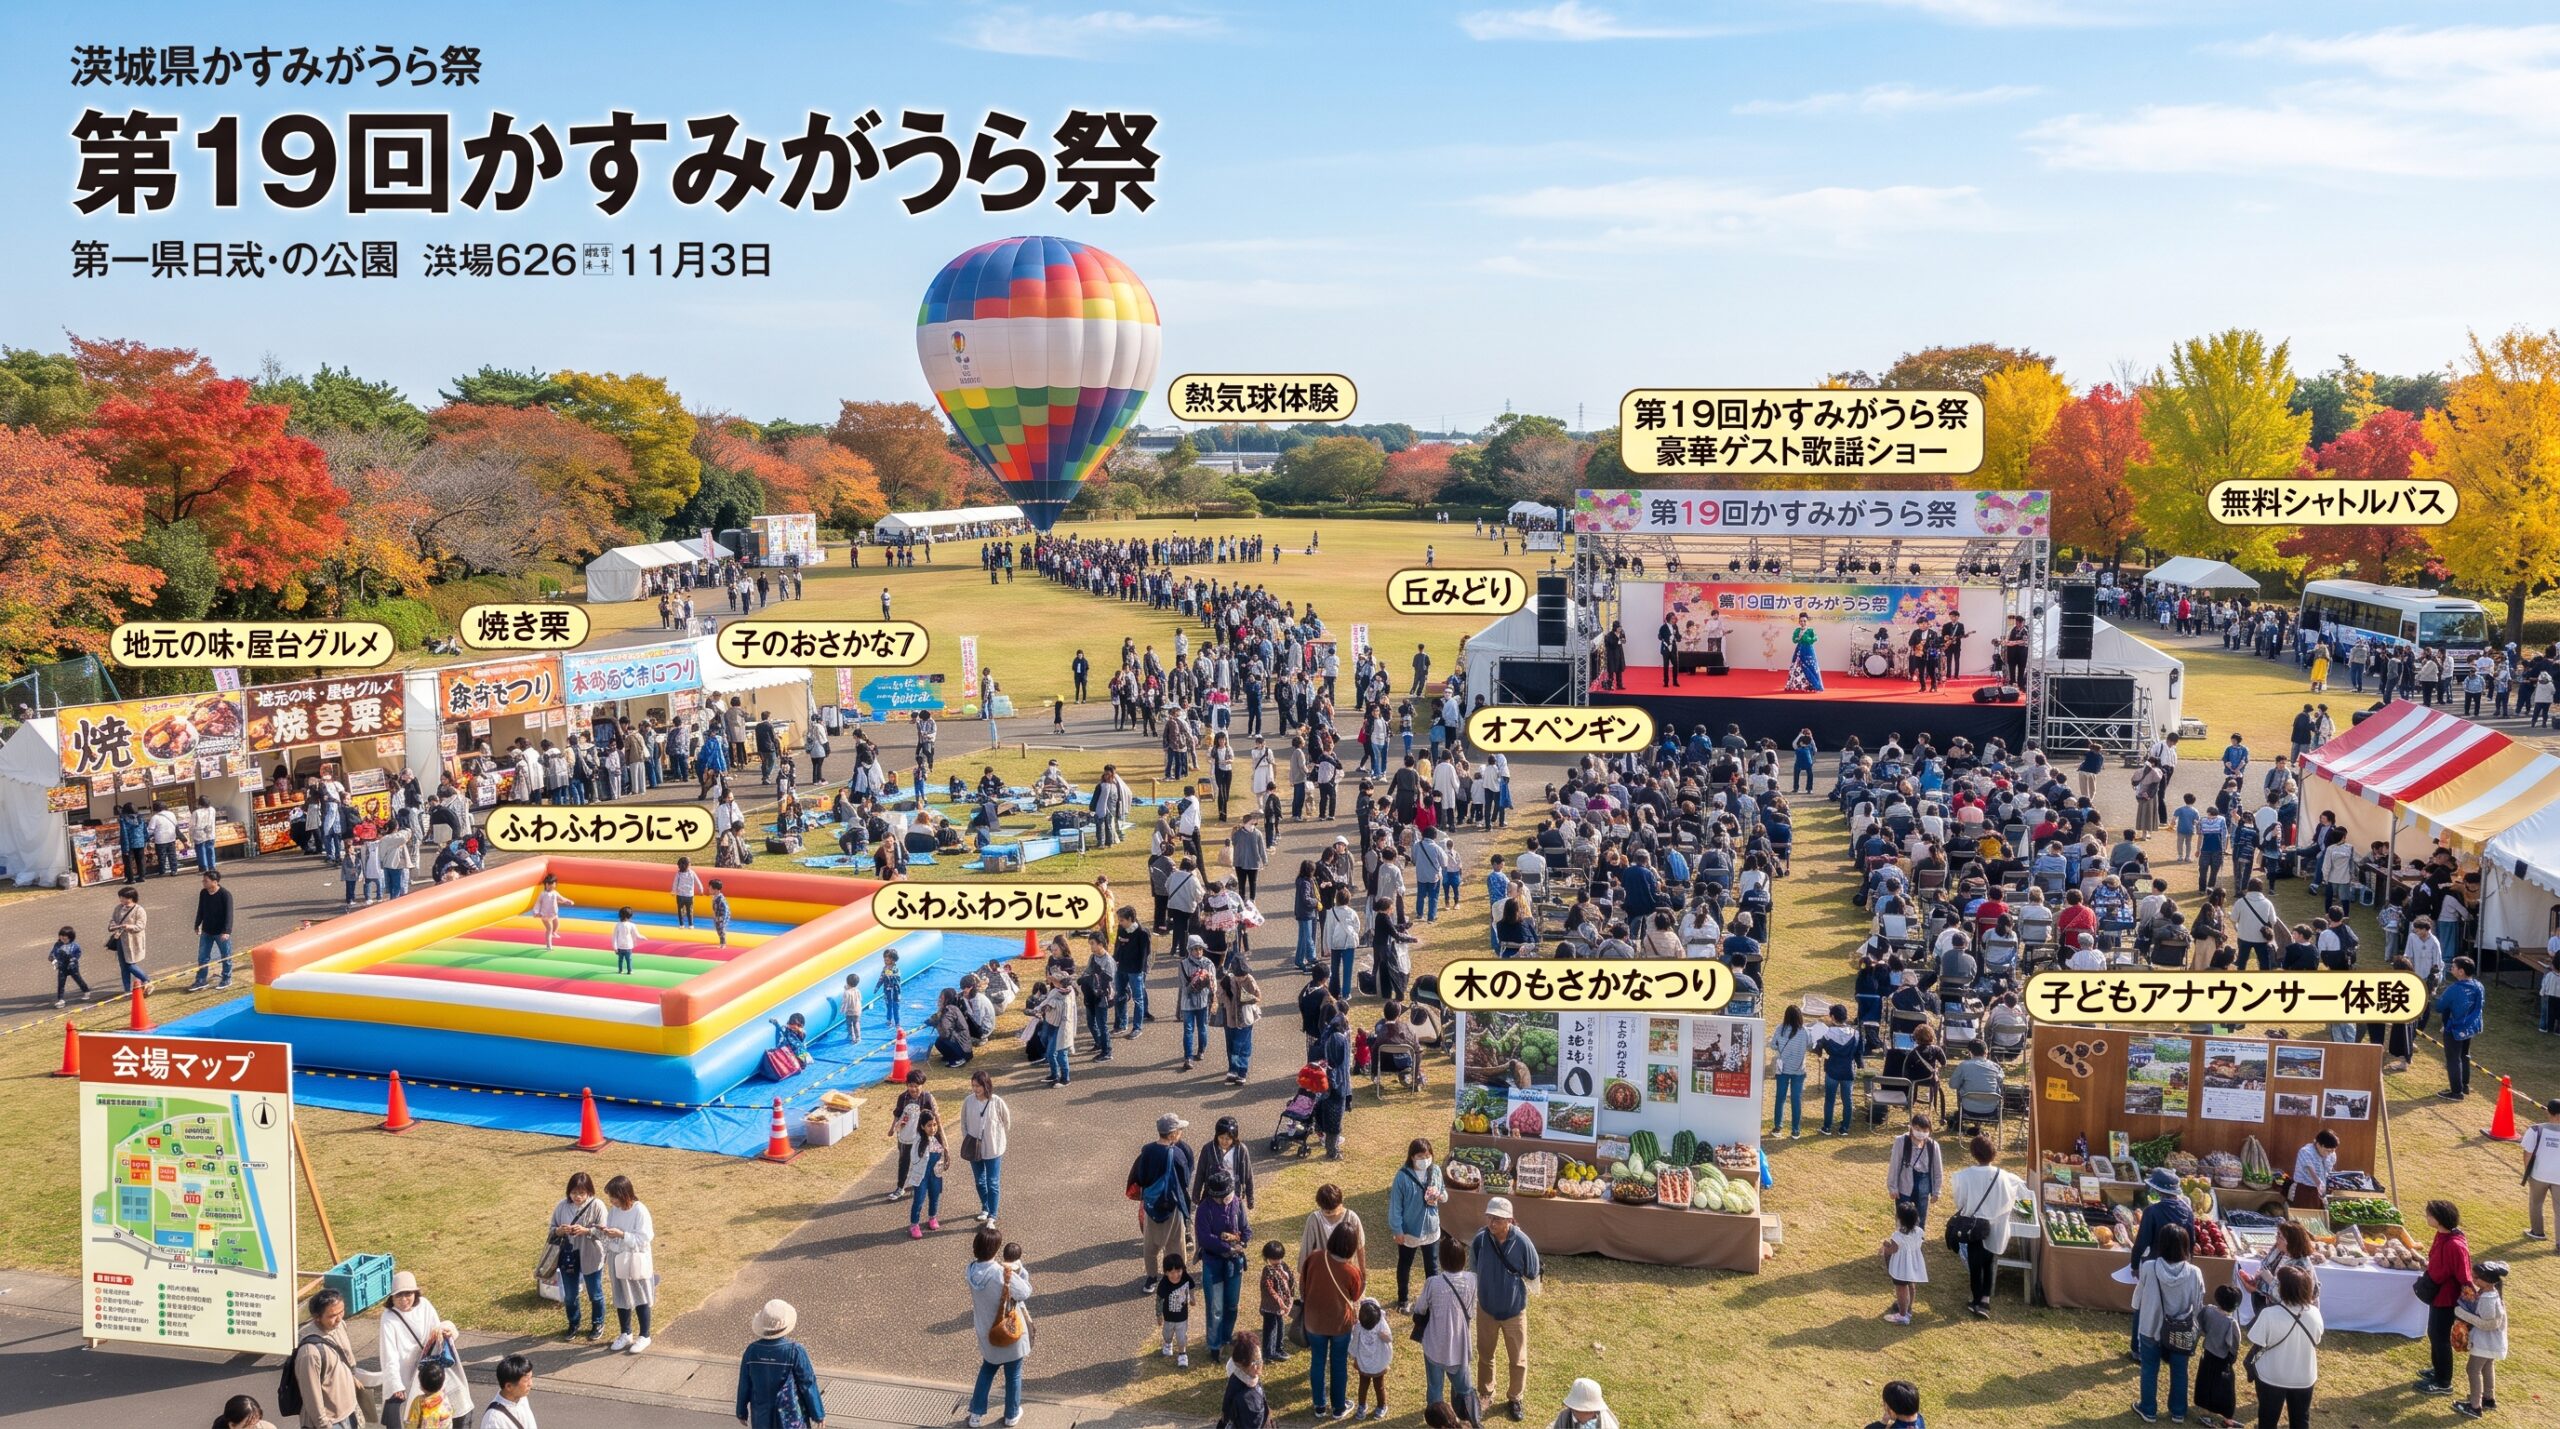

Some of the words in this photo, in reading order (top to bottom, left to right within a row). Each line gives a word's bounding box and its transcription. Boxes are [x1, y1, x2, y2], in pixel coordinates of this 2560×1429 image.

[1651, 499, 1957, 529] 第19回かすみがうら祭
[273, 697, 383, 743] 焼き栗
[111, 1045, 256, 1082] 会場マップ
